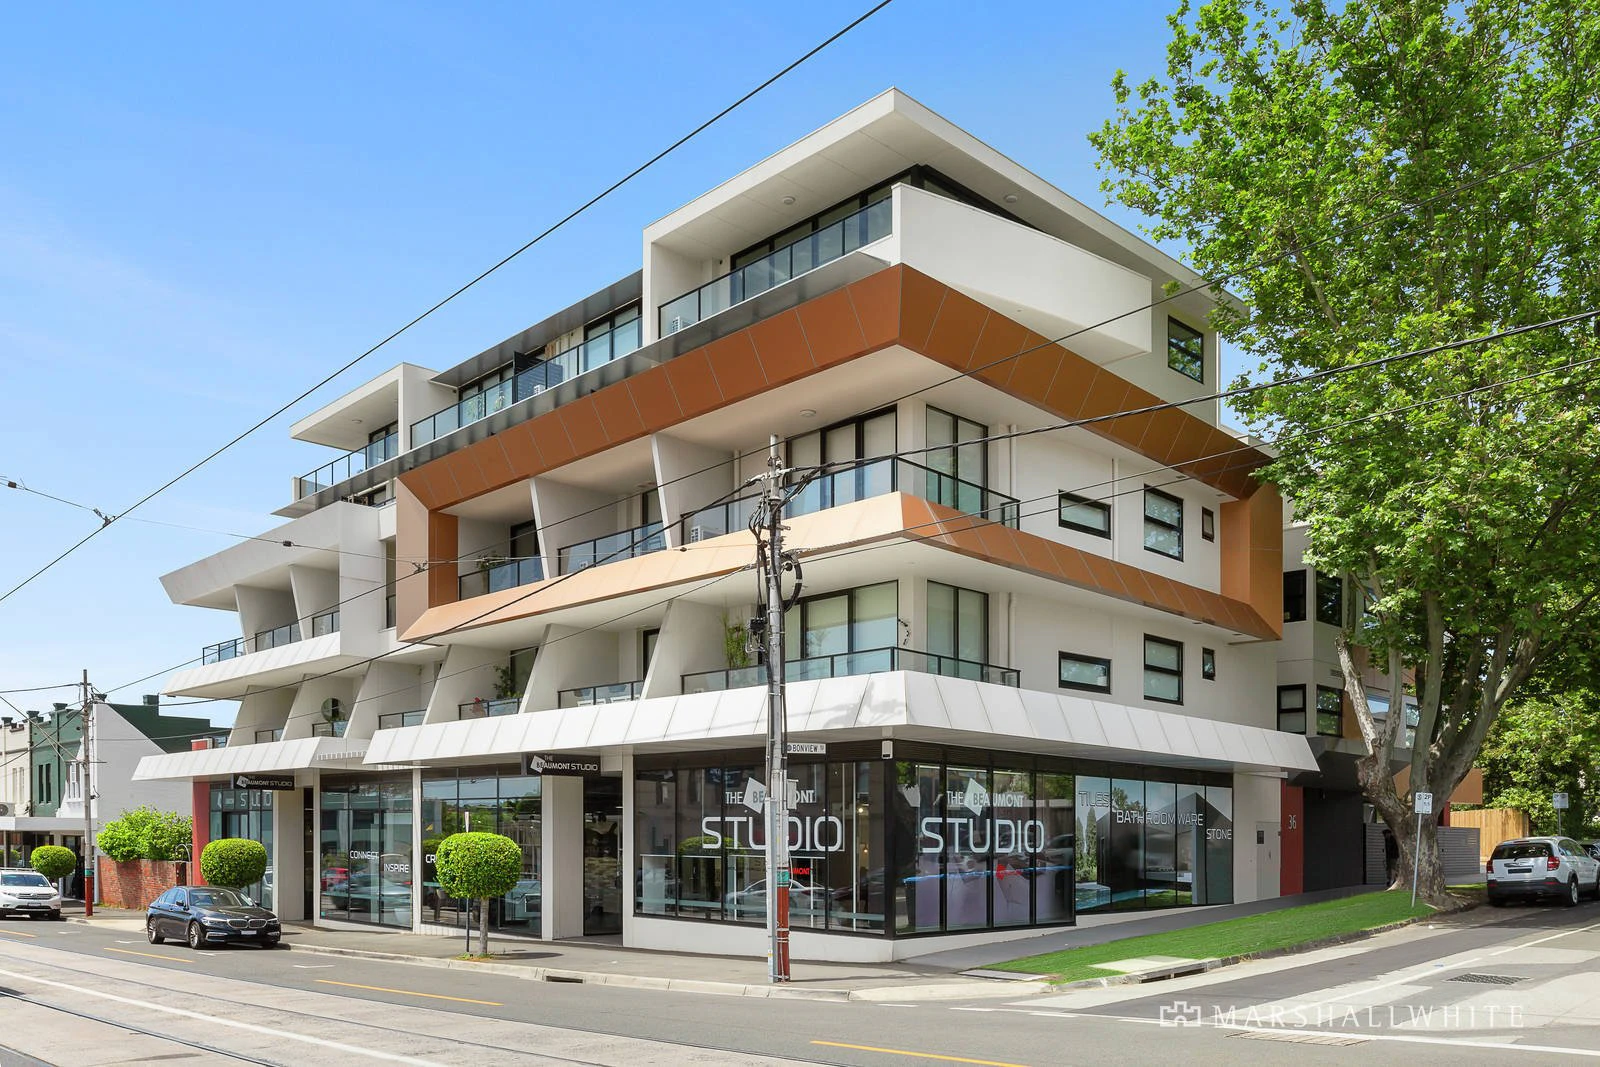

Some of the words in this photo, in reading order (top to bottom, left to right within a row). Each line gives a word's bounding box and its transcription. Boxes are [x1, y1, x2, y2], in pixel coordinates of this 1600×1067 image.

[792, 744, 818, 752] BONVIEW
[571, 763, 598, 771] STUDIO
[725, 791, 743, 804] THE
[752, 790, 815, 803] BEONT
[946, 790, 964, 805] THE
[973, 792, 1024, 807] BEAUMONT
[1079, 791, 1110, 807] TILES
[1288, 814, 1297, 830] 36
[702, 816, 843, 852] STUDIO
[921, 817, 1044, 853] STUDIO
[1206, 828, 1232, 840] STONE
[350, 850, 379, 860] CONNECT
[384, 863, 410, 873] INSPIRE
